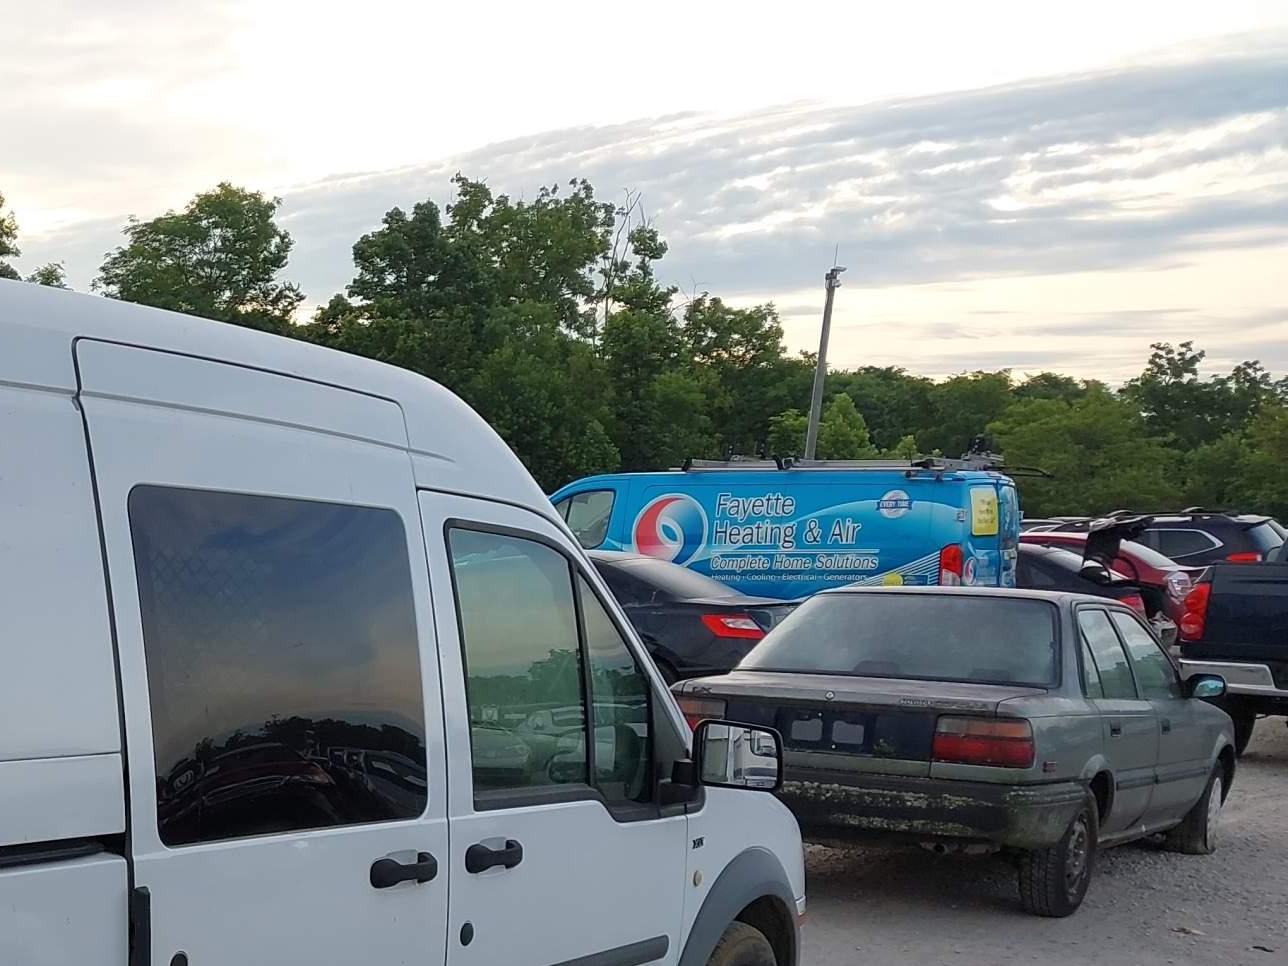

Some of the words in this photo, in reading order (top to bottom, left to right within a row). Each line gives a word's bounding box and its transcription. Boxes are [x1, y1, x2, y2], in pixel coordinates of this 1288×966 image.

[715, 492, 796, 522] Fayette
[713, 519, 797, 550] Heating
[803, 518, 822, 544] &
[827, 518, 862, 545] Air
[711, 554, 771, 572] Complete
[772, 554, 811, 570] Home
[815, 553, 879, 570] Solutions
[711, 573, 741, 582] Heating
[746, 573, 776, 582] Cooling
[781, 573, 817, 582] Electrical
[823, 573, 868, 582] Generators
